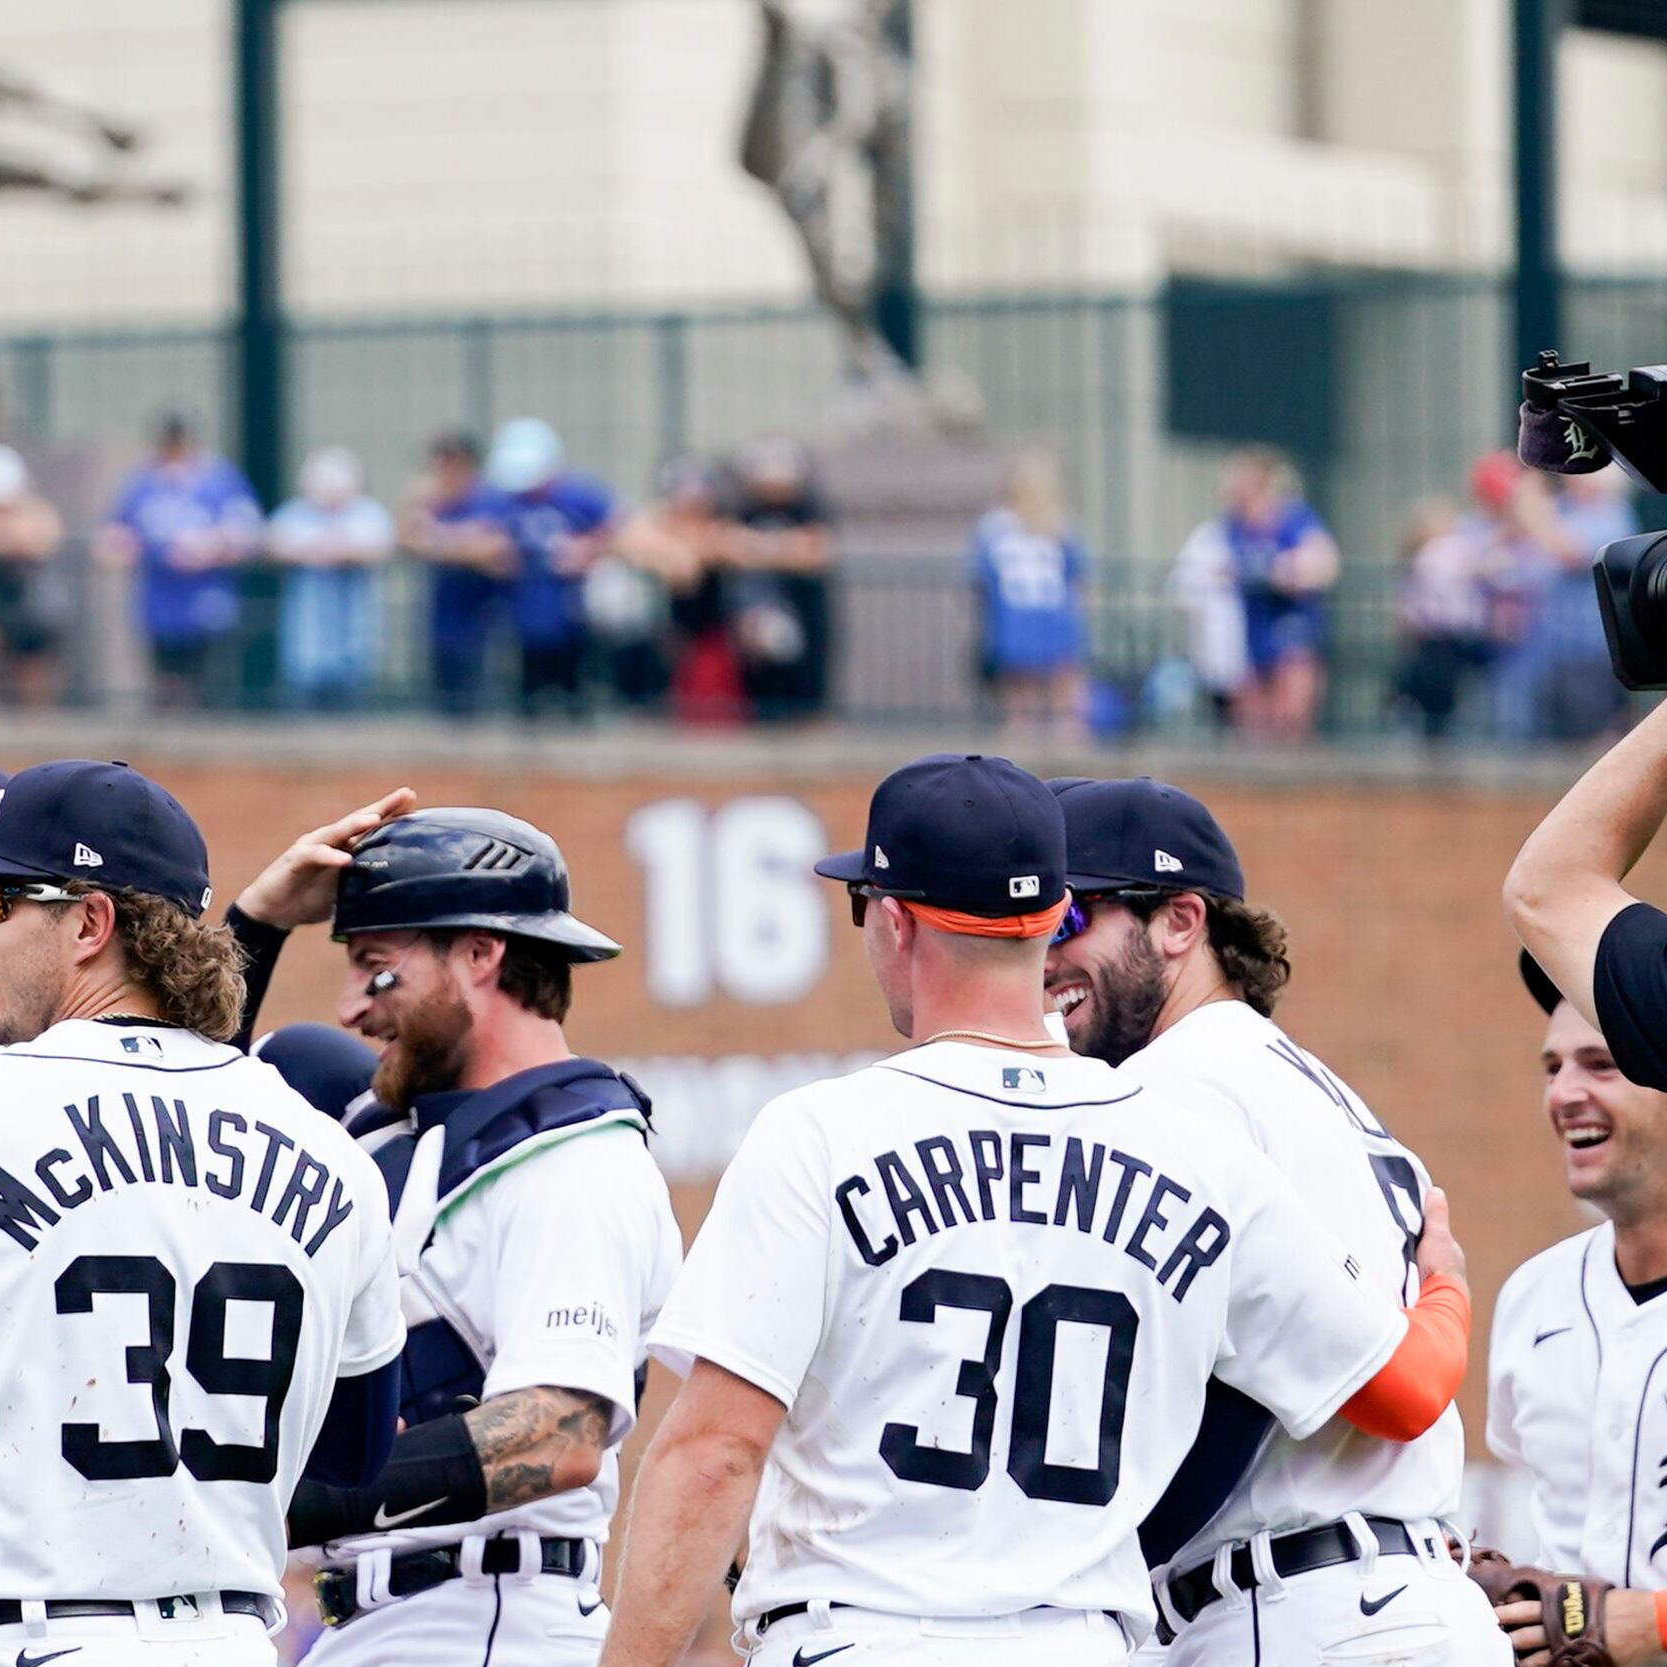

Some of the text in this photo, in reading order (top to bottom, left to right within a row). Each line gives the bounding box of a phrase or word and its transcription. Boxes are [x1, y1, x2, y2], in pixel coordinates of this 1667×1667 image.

[627, 796, 829, 1007] 16
[835, 1129, 1231, 1304] CARPENTER
[54, 1254, 305, 1484] 39
[878, 1267, 1141, 1508] 30
